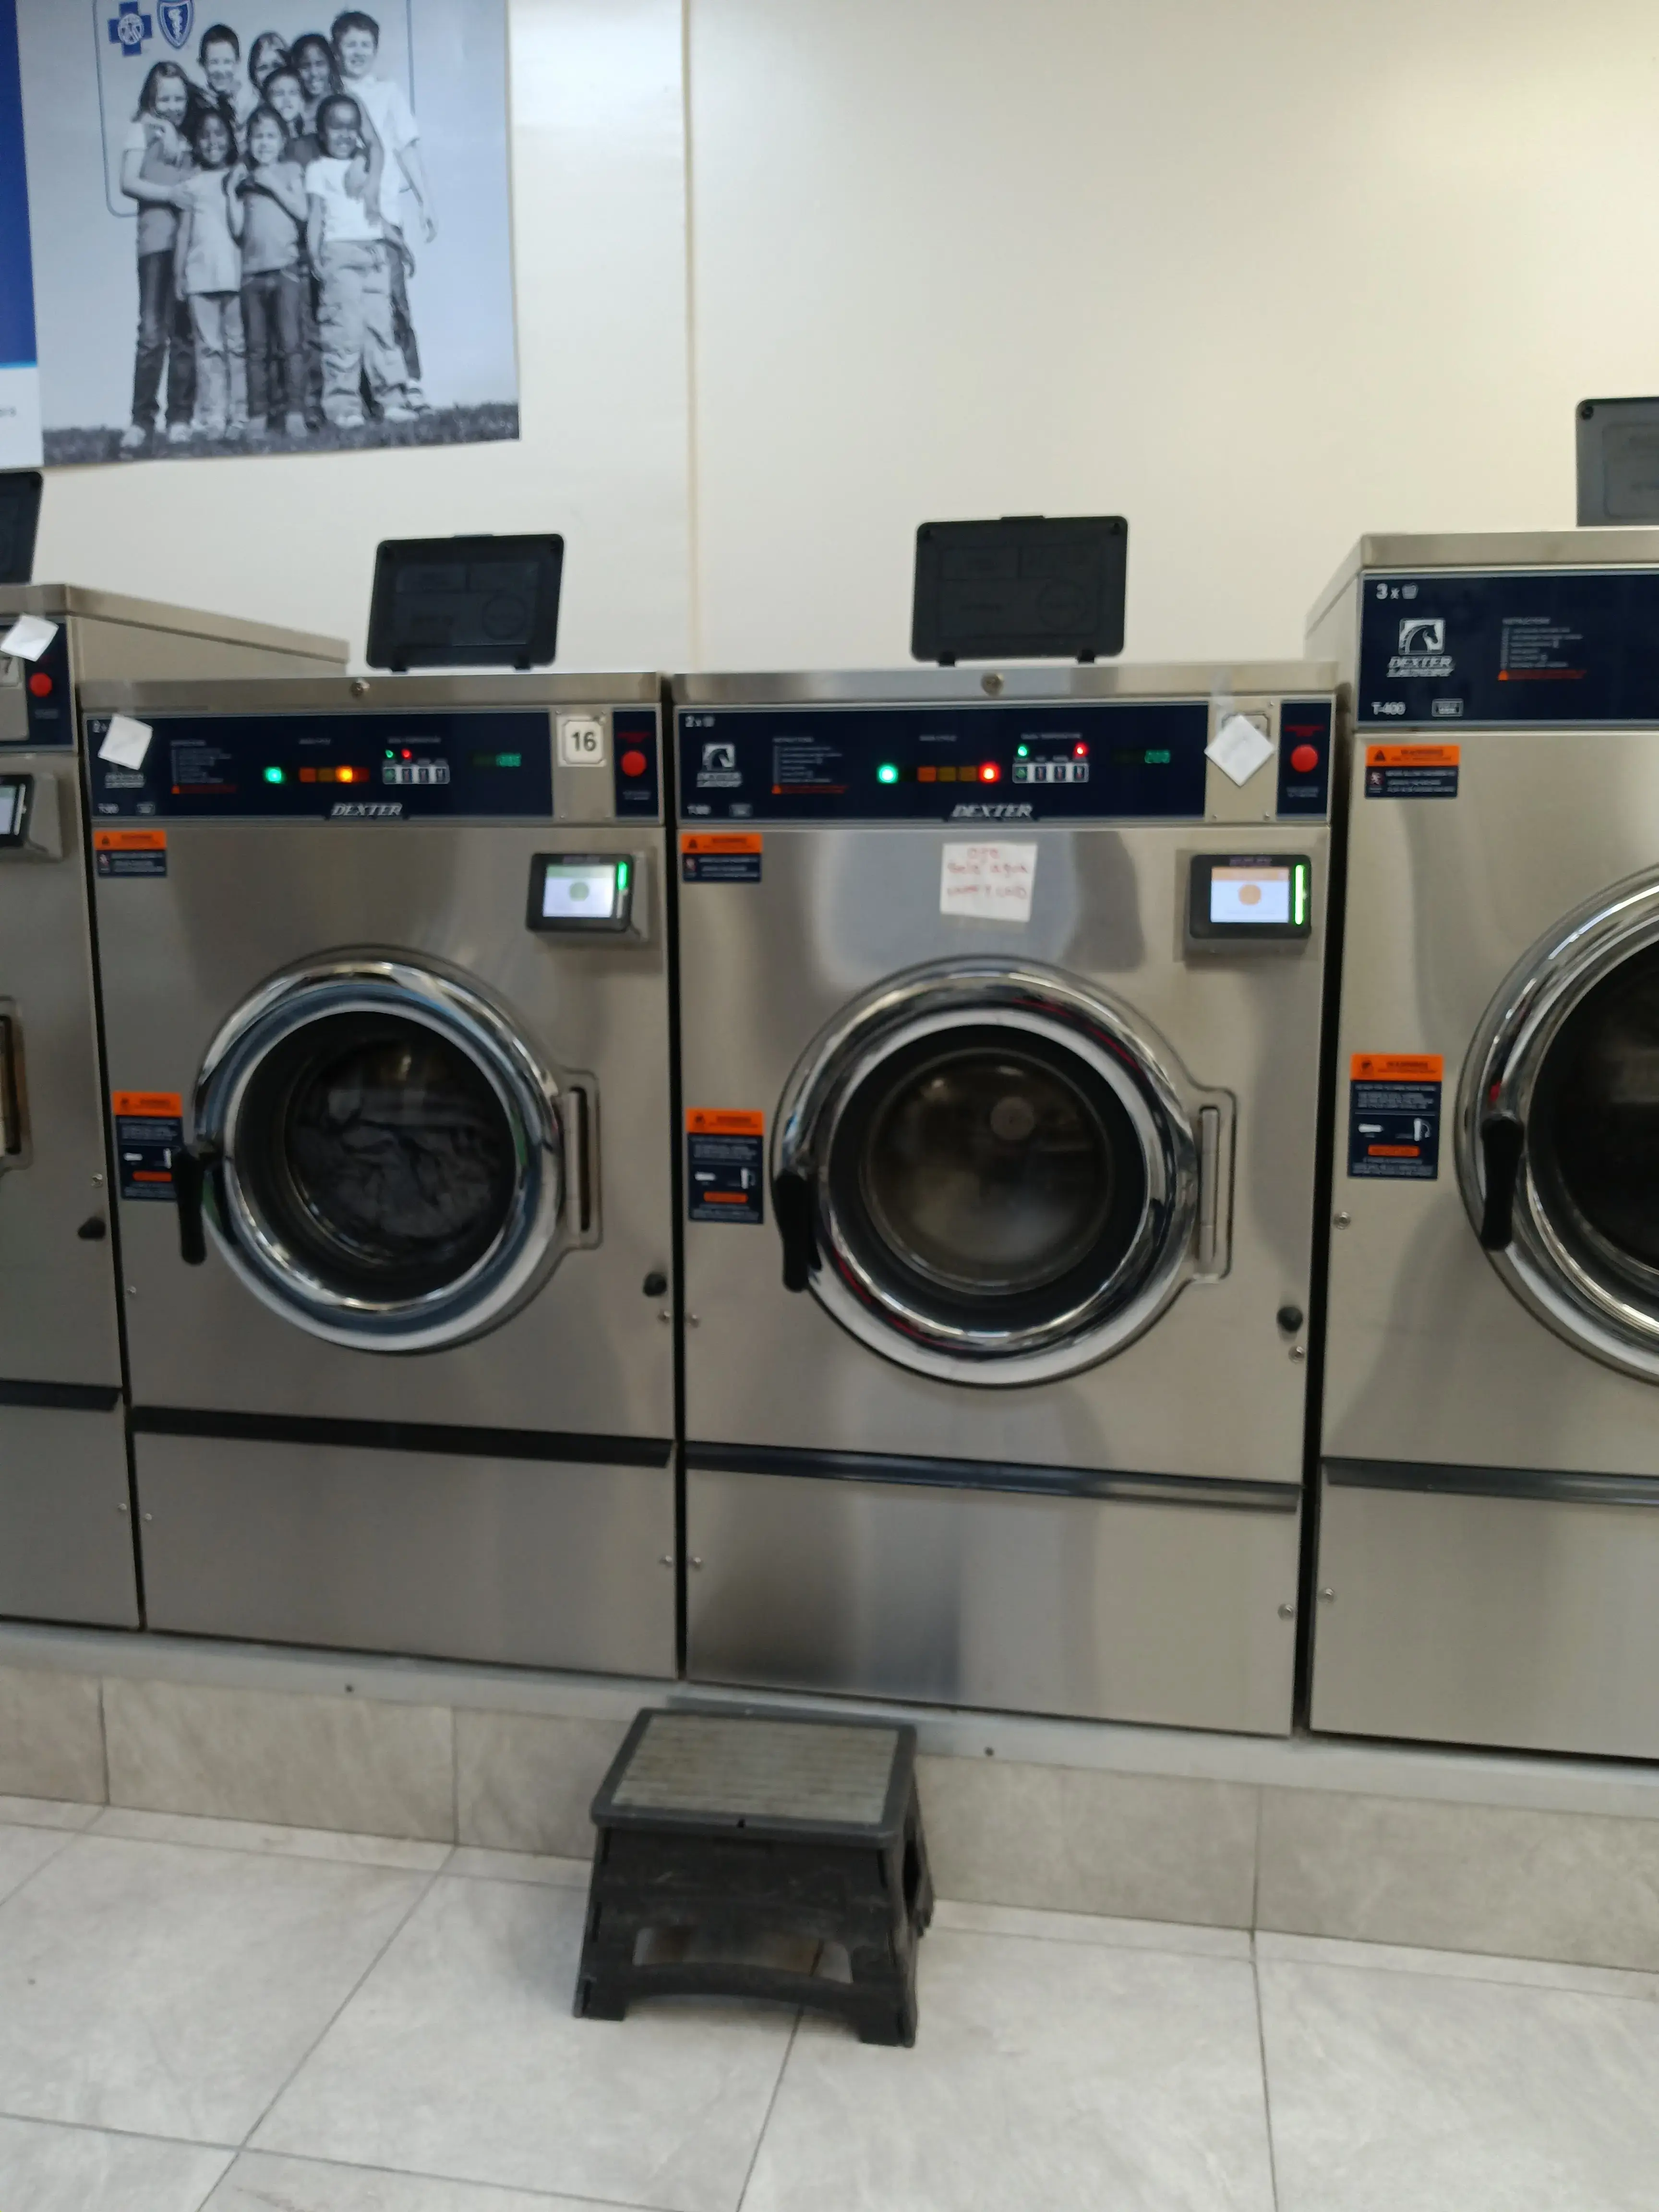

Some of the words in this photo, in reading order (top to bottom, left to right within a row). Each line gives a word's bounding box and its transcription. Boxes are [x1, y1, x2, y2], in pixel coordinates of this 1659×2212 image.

[1376, 583, 1388, 600] 3
[1387, 656, 1453, 668] DEXTER
[571, 731, 597, 752] 16
[331, 802, 403, 817] DEXTER
[950, 803, 1033, 817] DEXTER
